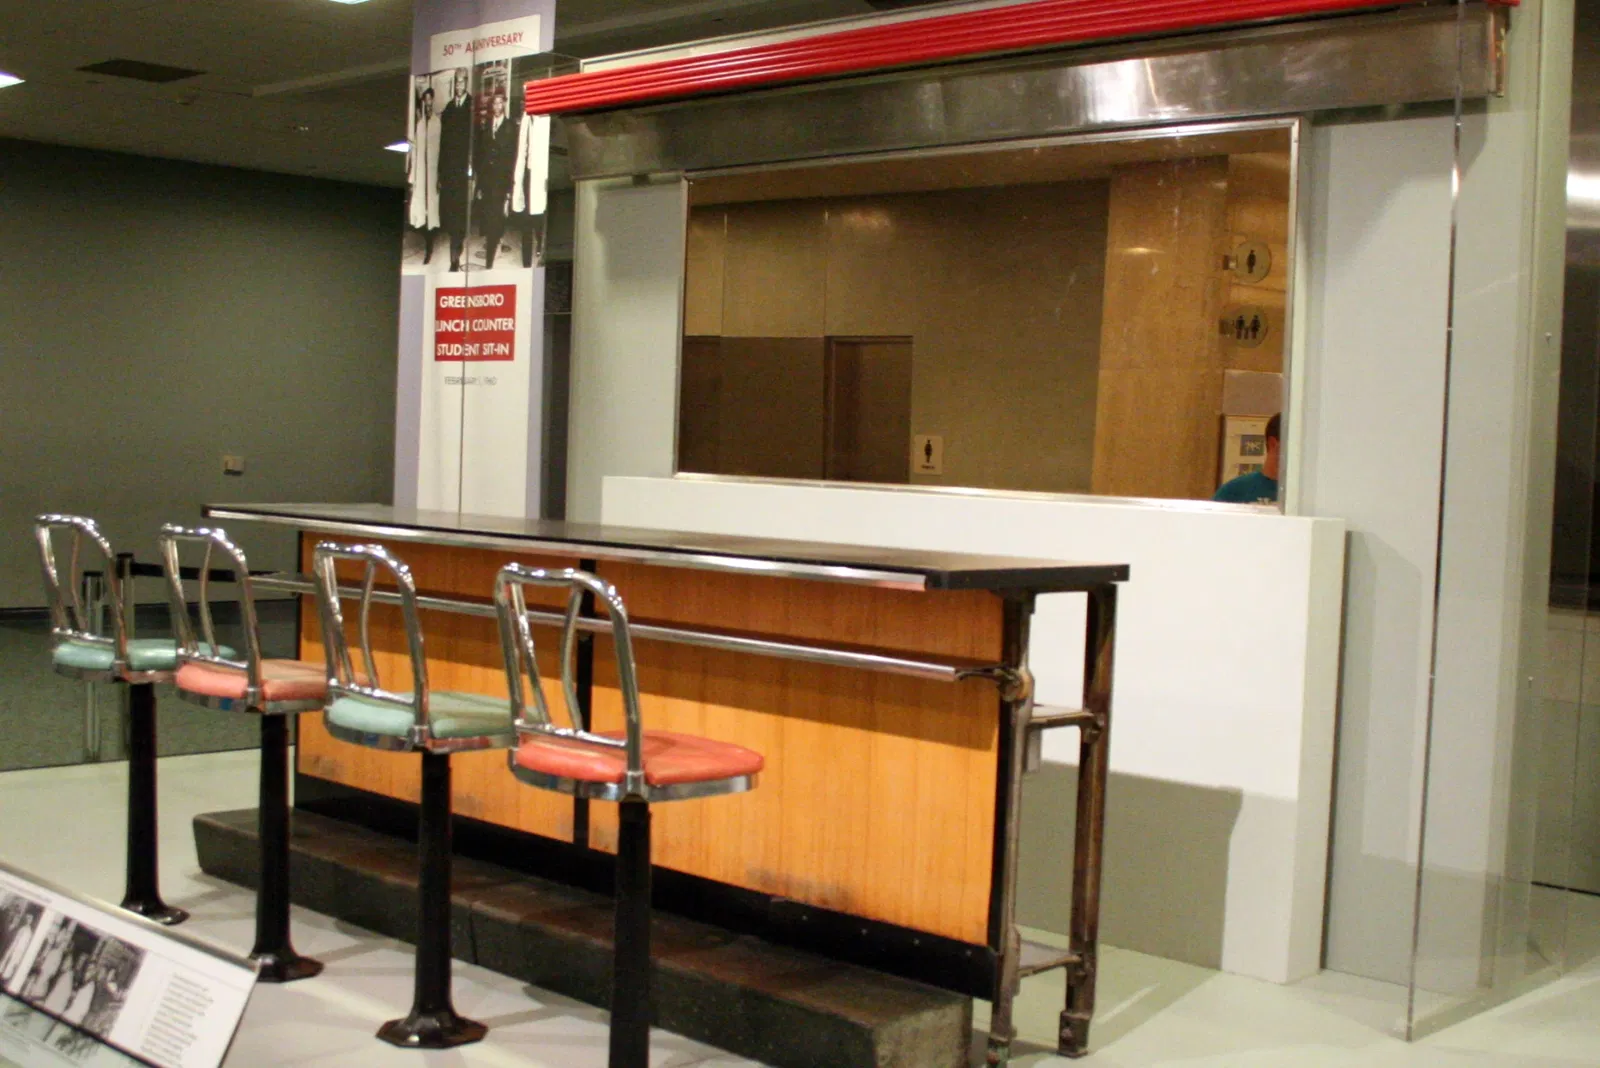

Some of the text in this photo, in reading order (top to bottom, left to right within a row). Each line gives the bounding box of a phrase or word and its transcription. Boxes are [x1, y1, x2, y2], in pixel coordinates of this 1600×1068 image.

[443, 44, 462, 56] 50TH
[440, 294, 504, 308] GREENSBORO
[473, 319, 514, 331] COUNTER
[437, 344, 509, 356] STUDENT SIT-IN
